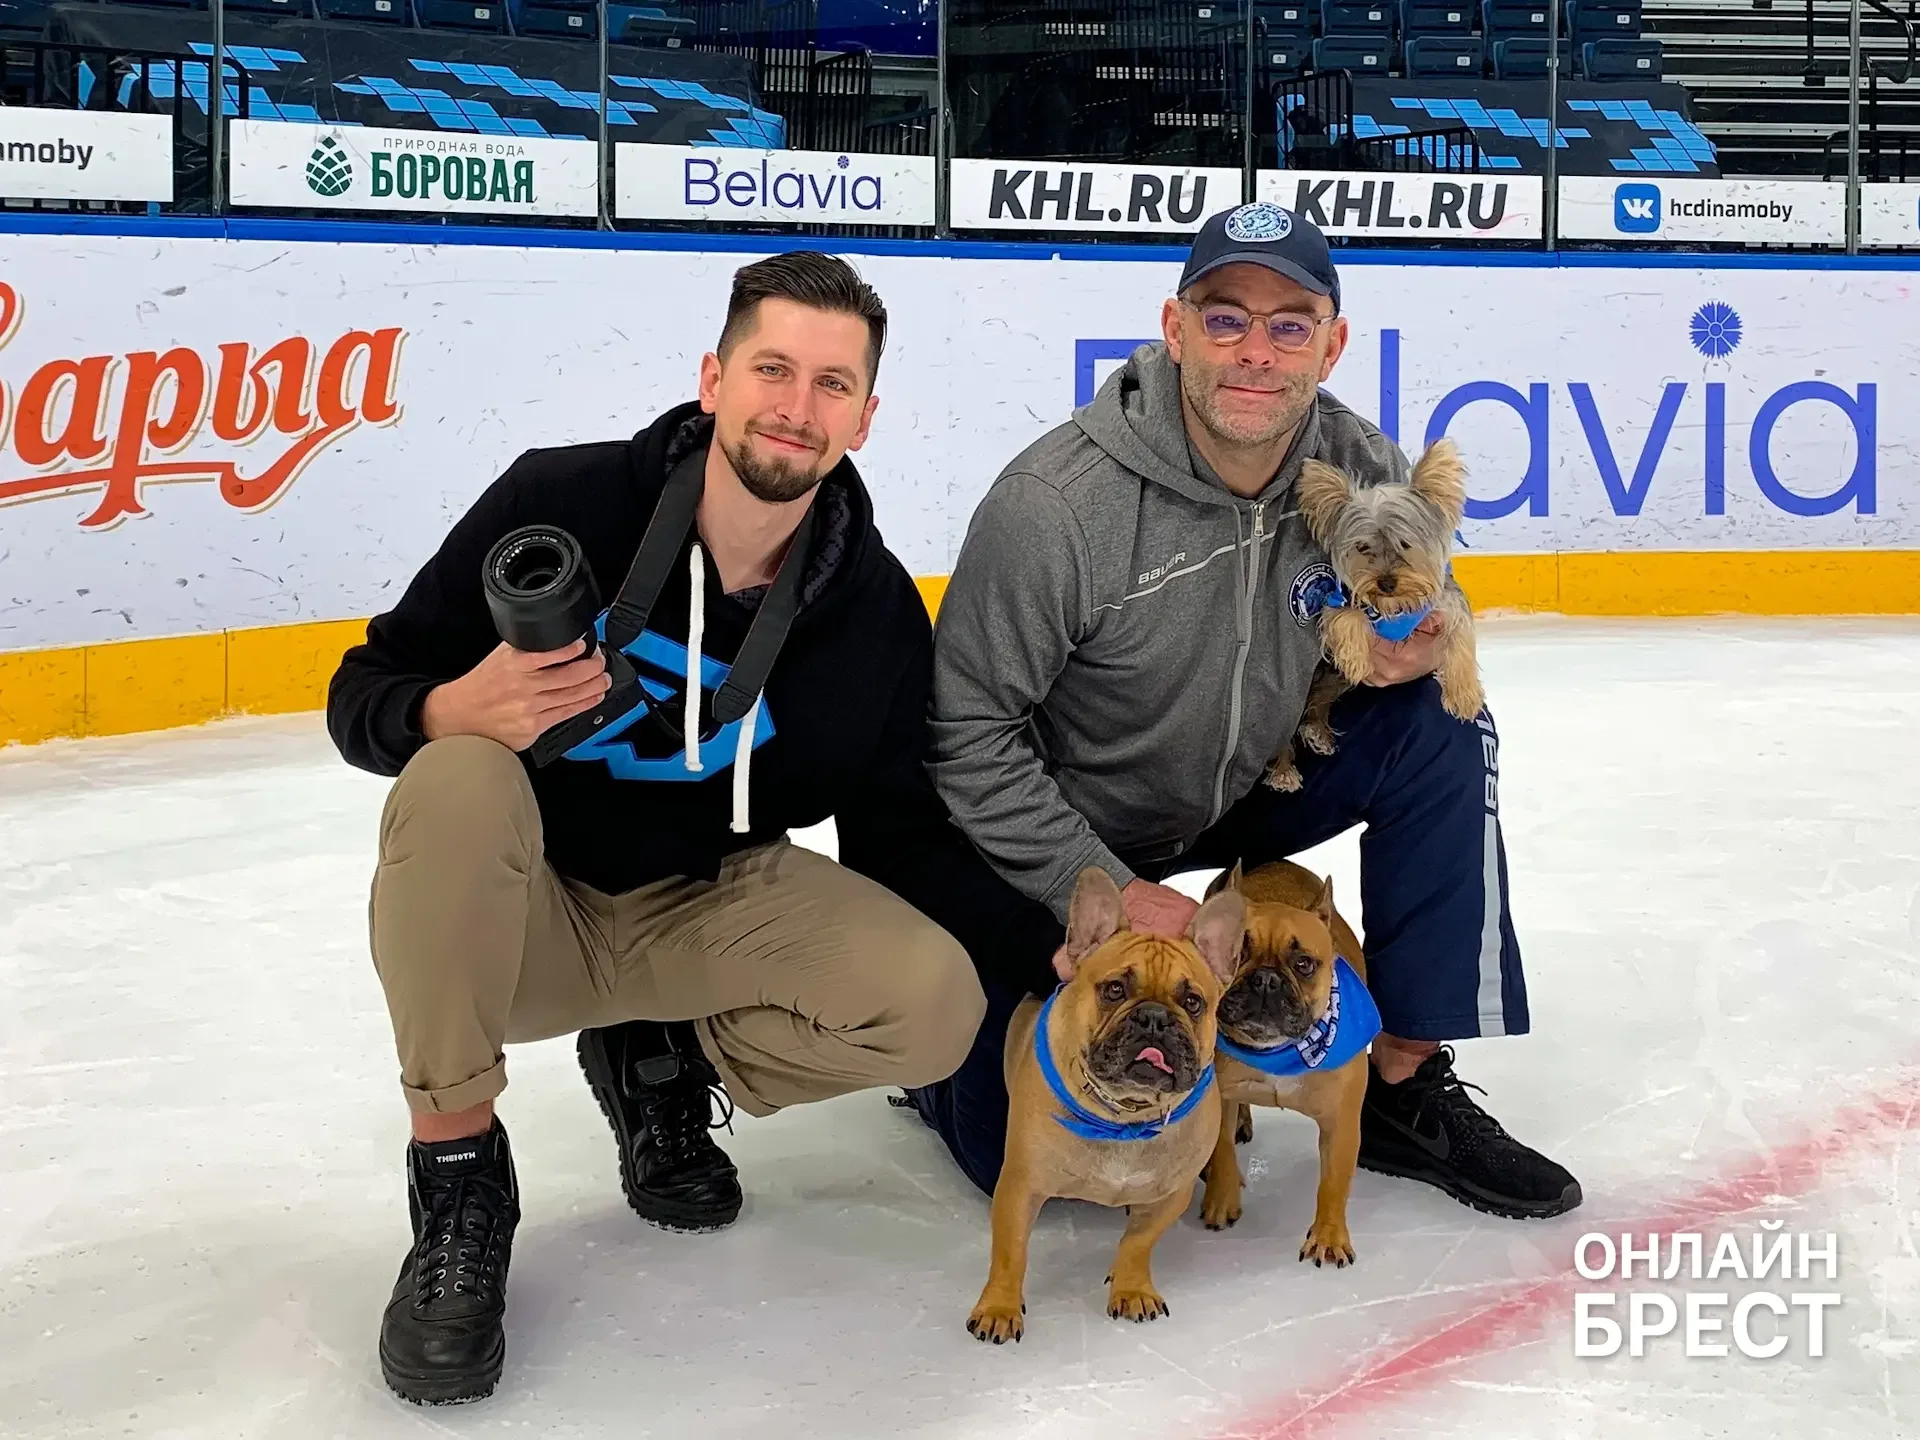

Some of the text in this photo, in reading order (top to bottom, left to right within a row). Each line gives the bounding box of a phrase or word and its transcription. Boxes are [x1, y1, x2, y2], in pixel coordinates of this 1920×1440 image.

[0, 138, 93, 170] moby
[383, 137, 525, 156] ПРИРОДНАЯ ВОДА
[370, 151, 535, 203] БОРОВАЯ
[684, 155, 882, 211] Belavia
[988, 169, 1208, 224] KHL.RU
[1294, 179, 1508, 230] KHL.RU
[1670, 198, 1793, 223] hcdinamoby
